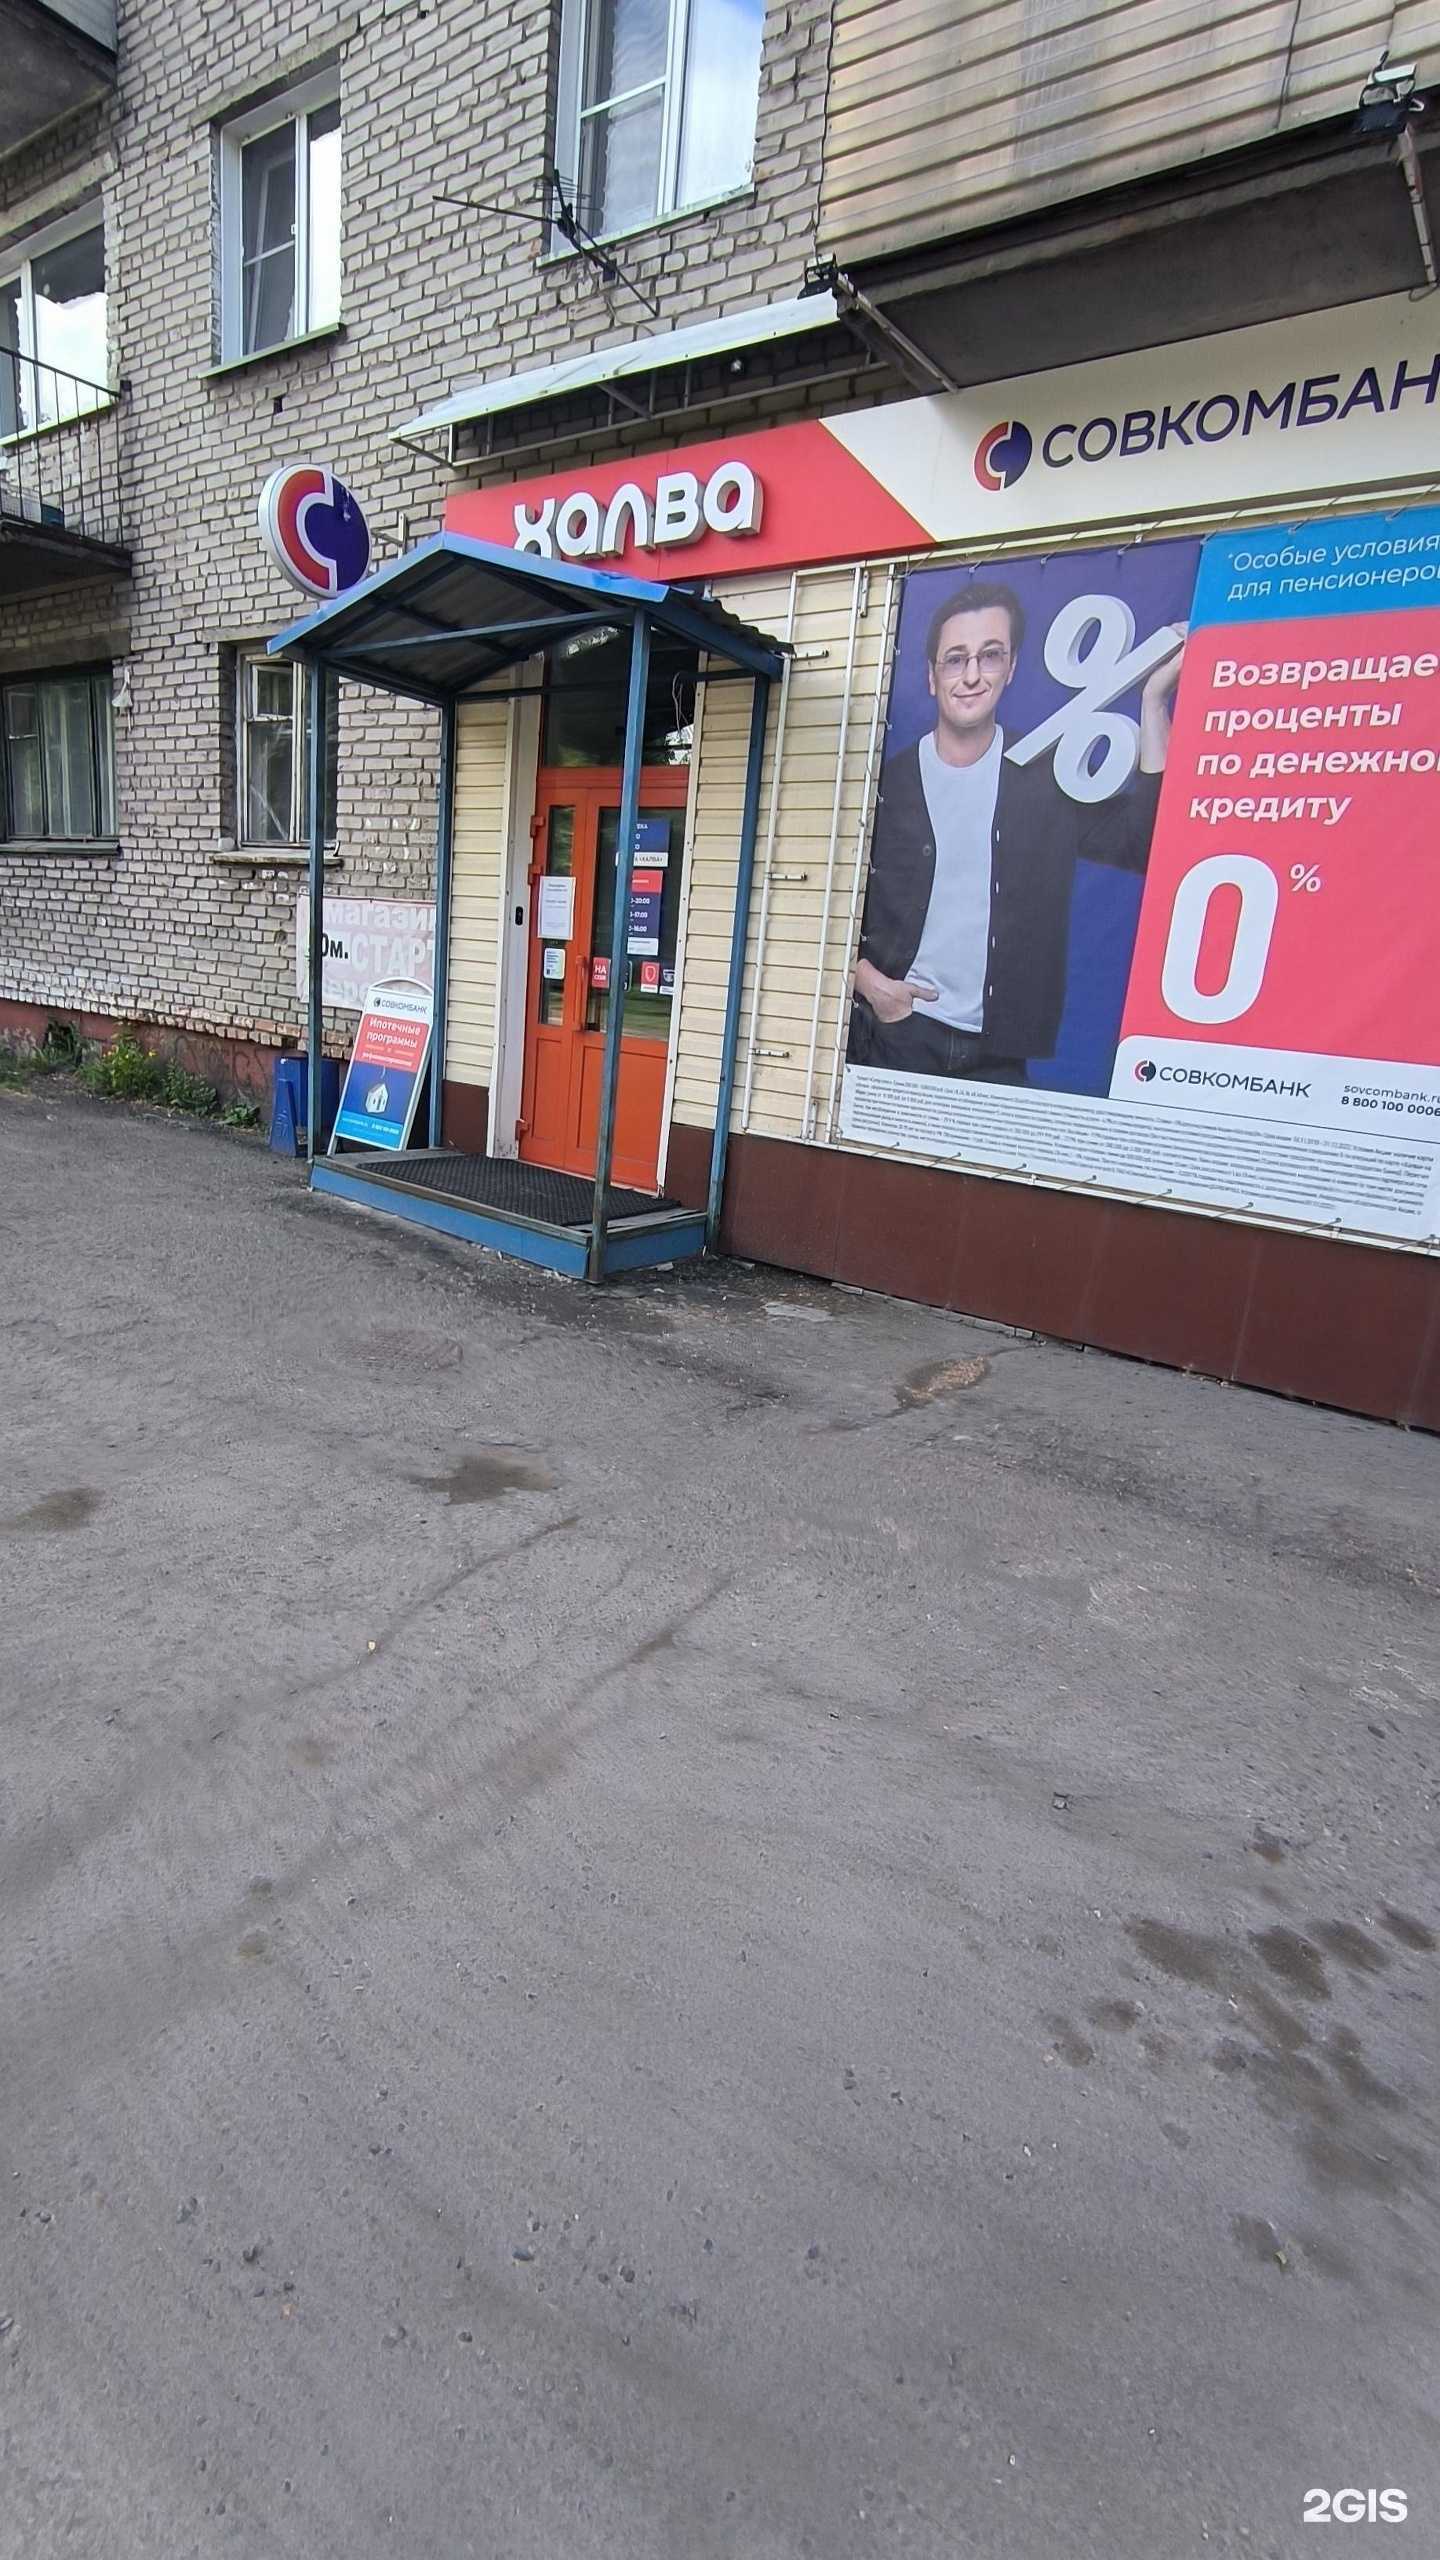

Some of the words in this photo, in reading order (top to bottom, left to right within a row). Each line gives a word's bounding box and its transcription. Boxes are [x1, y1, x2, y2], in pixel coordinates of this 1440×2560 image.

[1042, 354, 1440, 468] СОВКОМБАН
[1331, 534, 1440, 565] условия
[1227, 581, 1272, 601] для
[1212, 651, 1439, 690] Возвращае
[1204, 703, 1402, 737] проценты
[1196, 753, 1242, 776] по
[1249, 748, 1440, 779] денежно
[1189, 796, 1352, 826] кредиту
[366, 1030, 418, 1049] программы
[369, 1016, 421, 1035] Ипотечные
[1159, 1066, 1312, 1098] СОВКОМБАНК
[1341, 1096, 1350, 1105] 8
[1352, 1097, 1378, 1109] 800
[1382, 1100, 1404, 1112] 100
[1407, 1104, 1440, 1117] 0006
